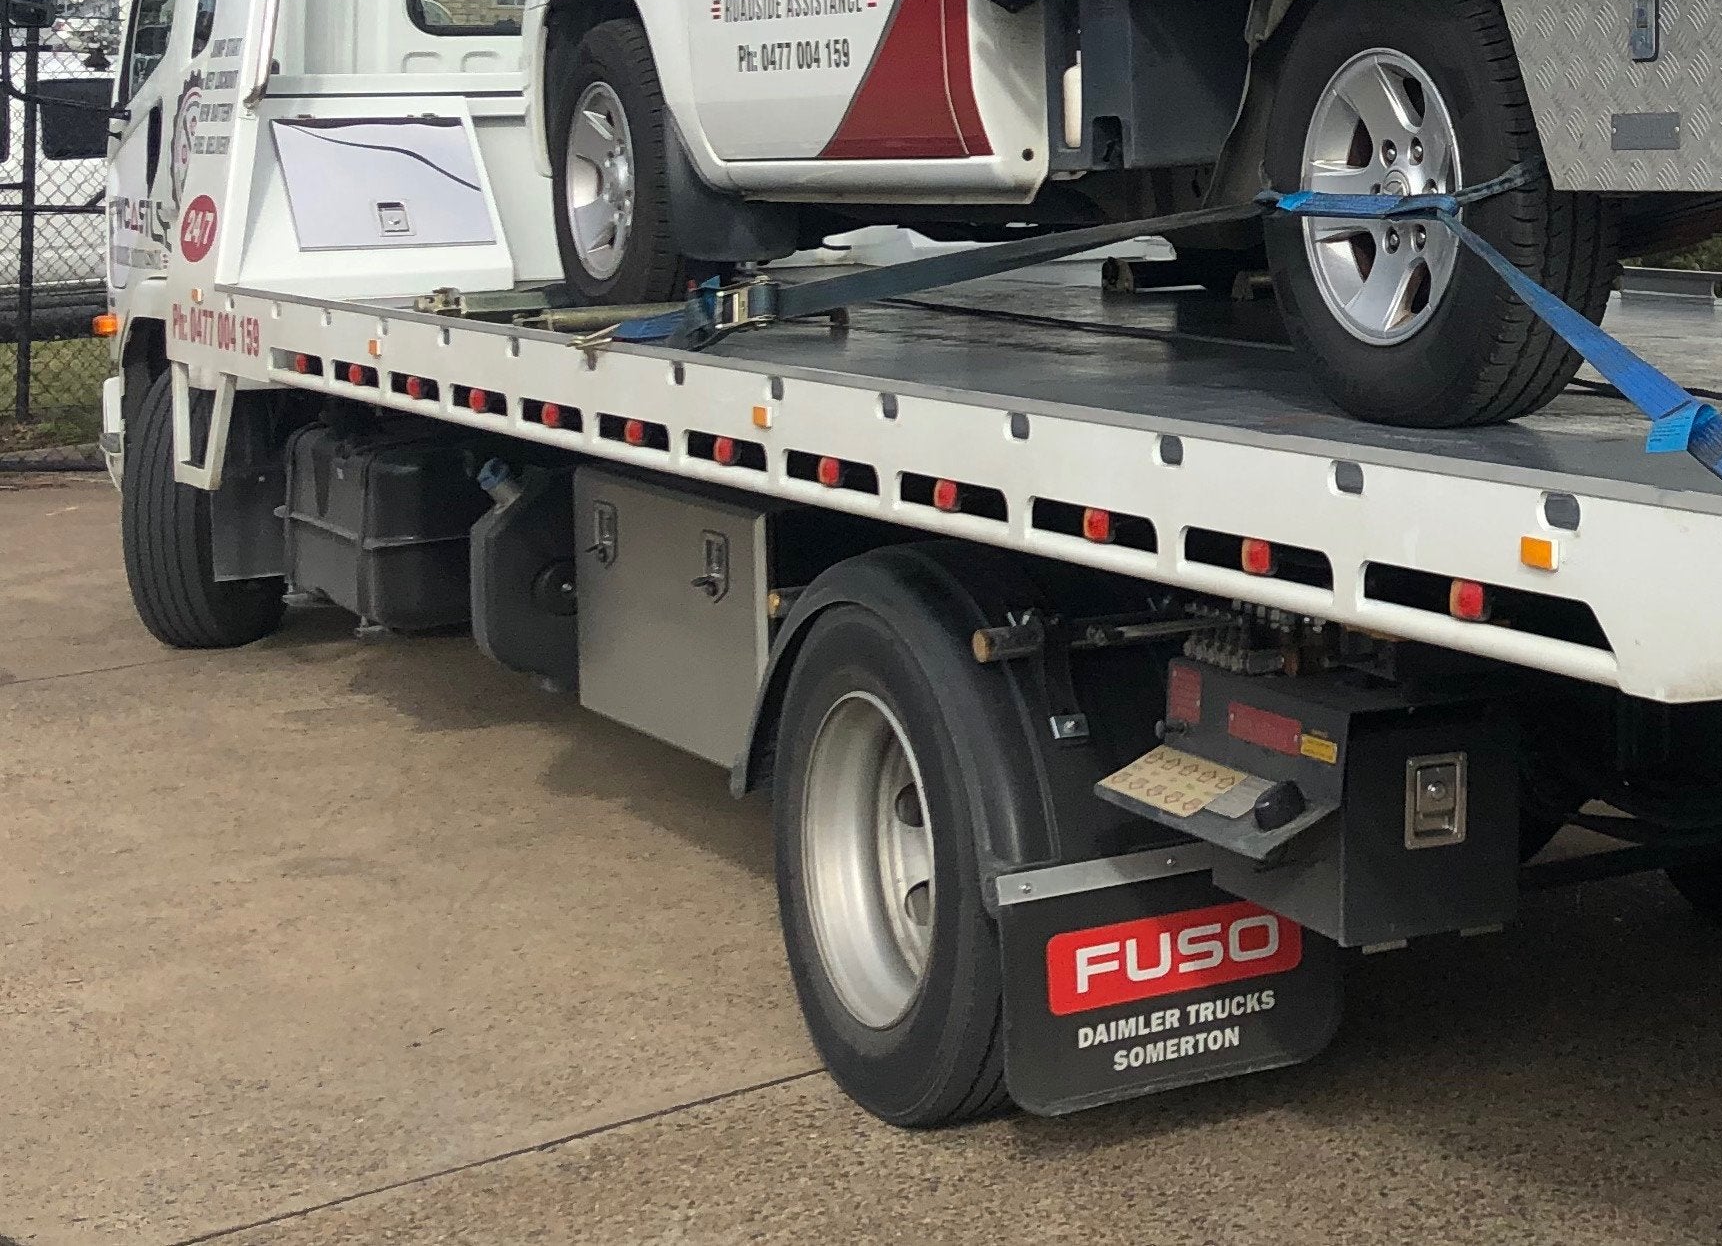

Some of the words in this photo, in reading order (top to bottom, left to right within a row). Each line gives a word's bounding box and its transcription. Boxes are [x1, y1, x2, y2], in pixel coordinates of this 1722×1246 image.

[761, 42, 792, 71] 0477
[796, 41, 821, 70] 004
[825, 38, 851, 68] 159
[1075, 913, 1280, 994] FUSO
[1077, 1007, 1180, 1050] DAIMLER
[1187, 989, 1276, 1025] TRUCKS
[1112, 1026, 1241, 1072] SOMERTON
